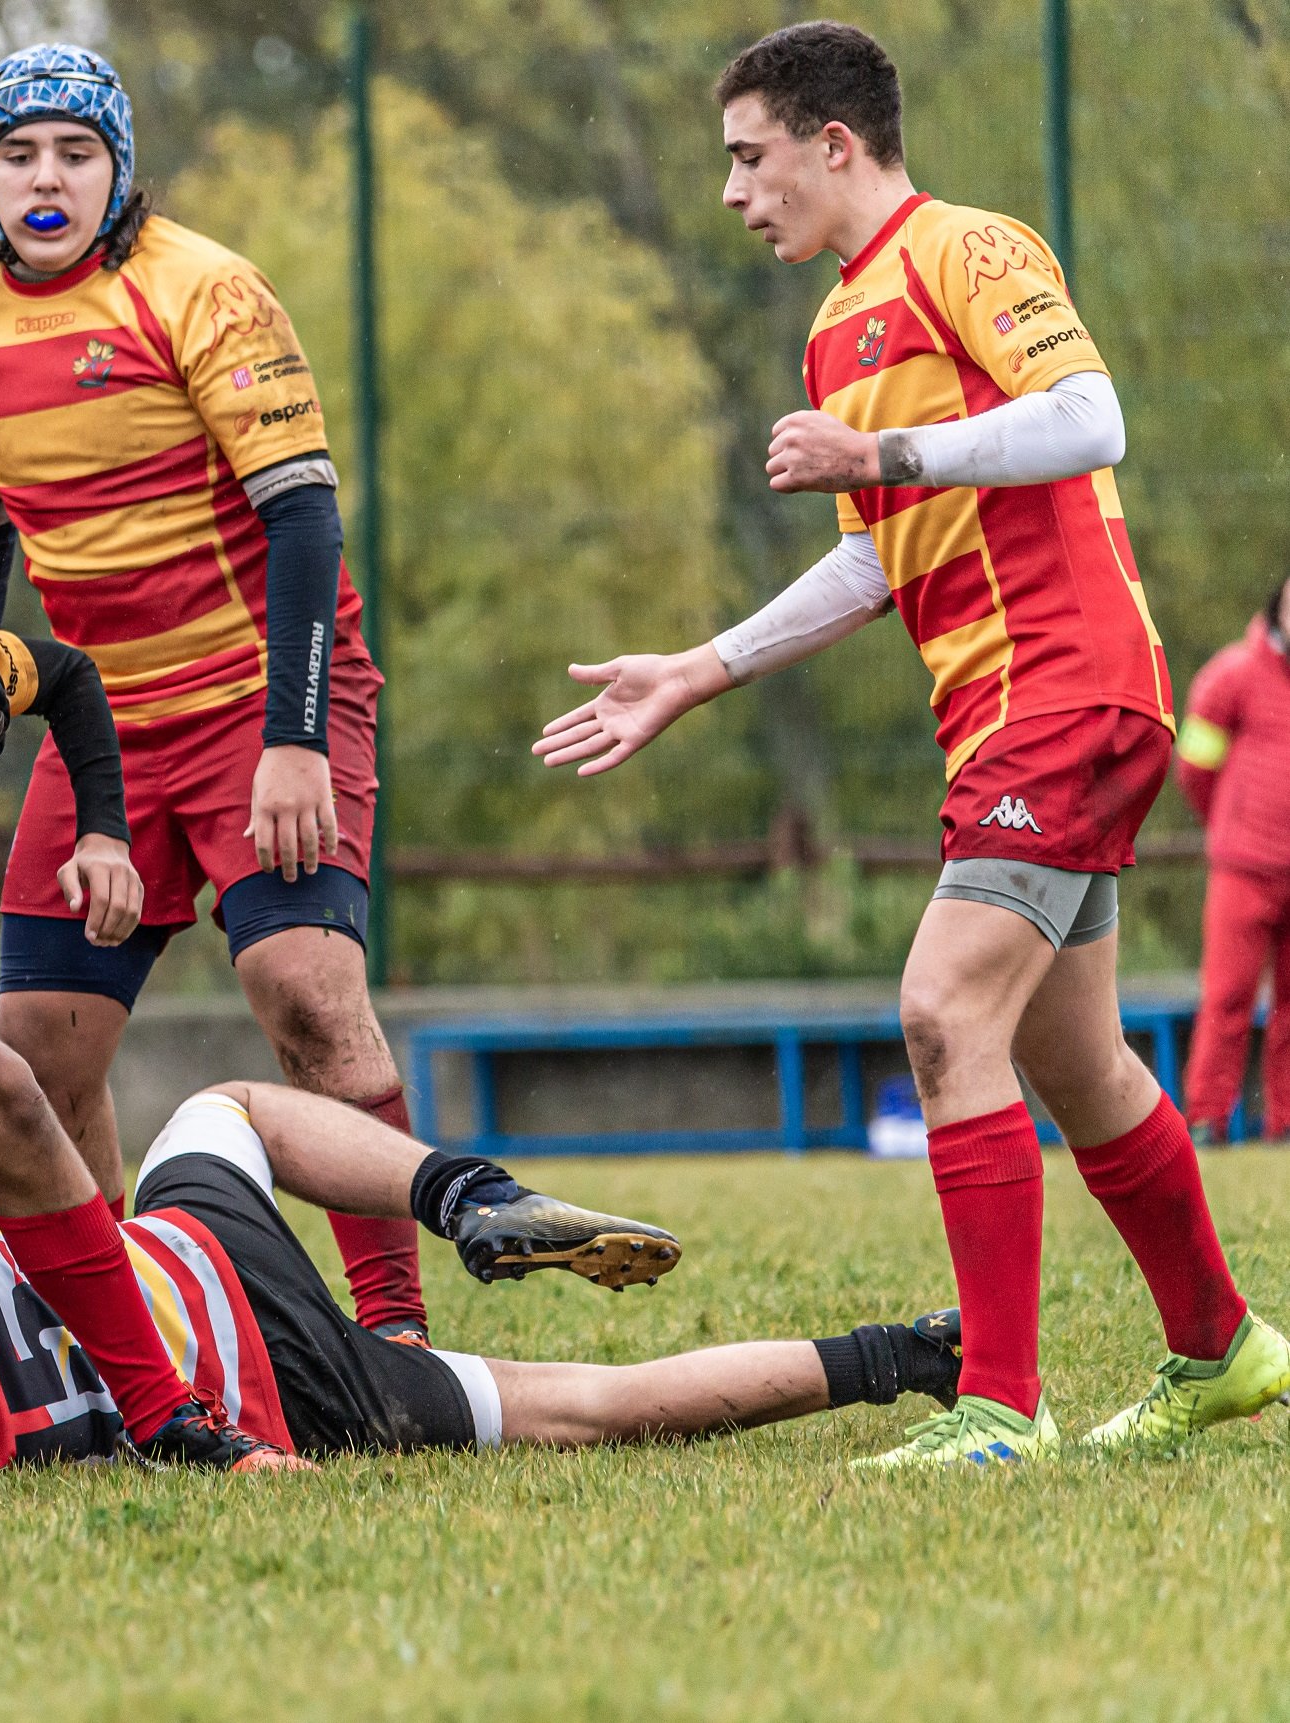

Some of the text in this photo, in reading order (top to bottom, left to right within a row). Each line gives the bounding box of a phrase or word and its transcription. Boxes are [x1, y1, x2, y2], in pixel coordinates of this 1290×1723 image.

[827, 291, 864, 319] Kappa
[16, 312, 74, 335] Kappa
[1018, 313, 1031, 324] de
[303, 620, 324, 734] RUGBYTECH
